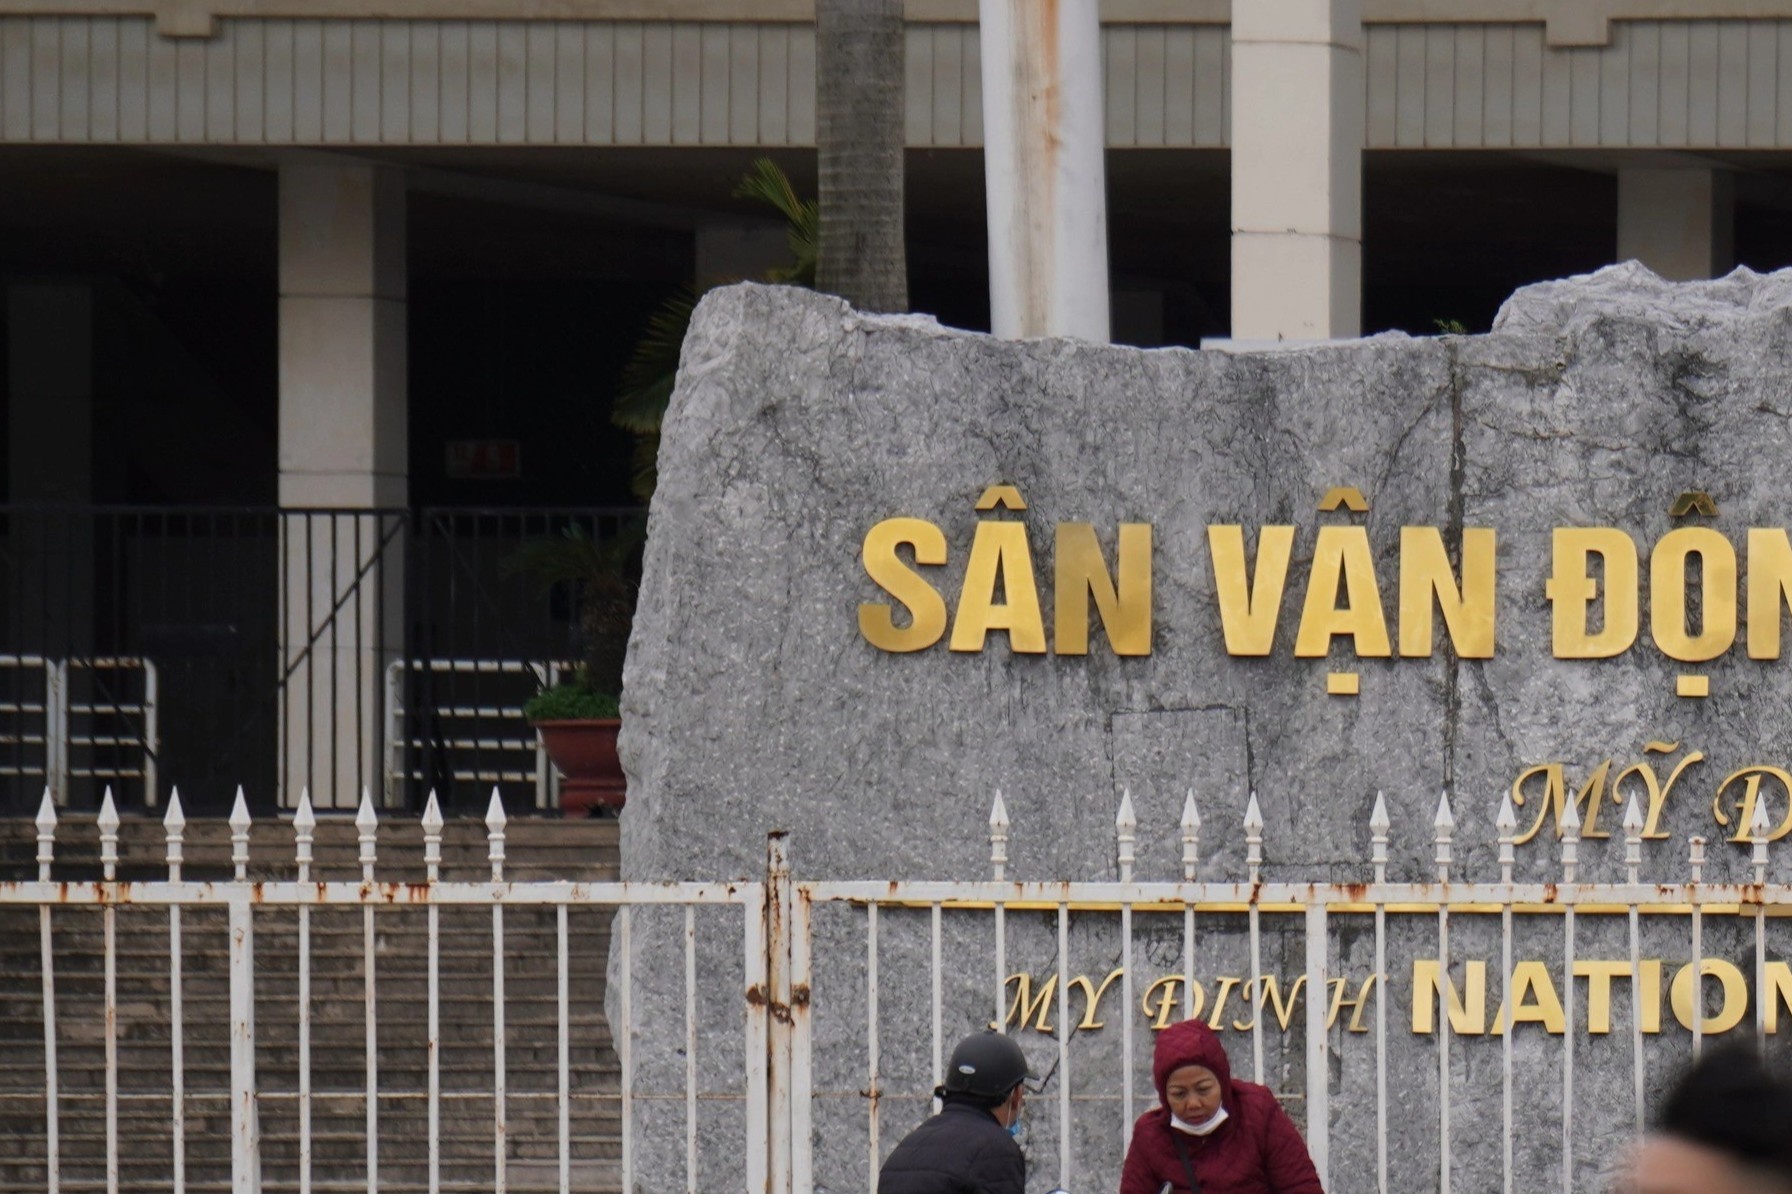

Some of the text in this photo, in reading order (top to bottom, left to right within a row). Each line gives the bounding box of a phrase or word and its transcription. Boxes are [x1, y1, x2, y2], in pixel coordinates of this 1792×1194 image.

[857, 485, 1152, 655] SÂN
[1207, 486, 1496, 696] VẬN
[1511, 740, 1704, 846] MỸ
